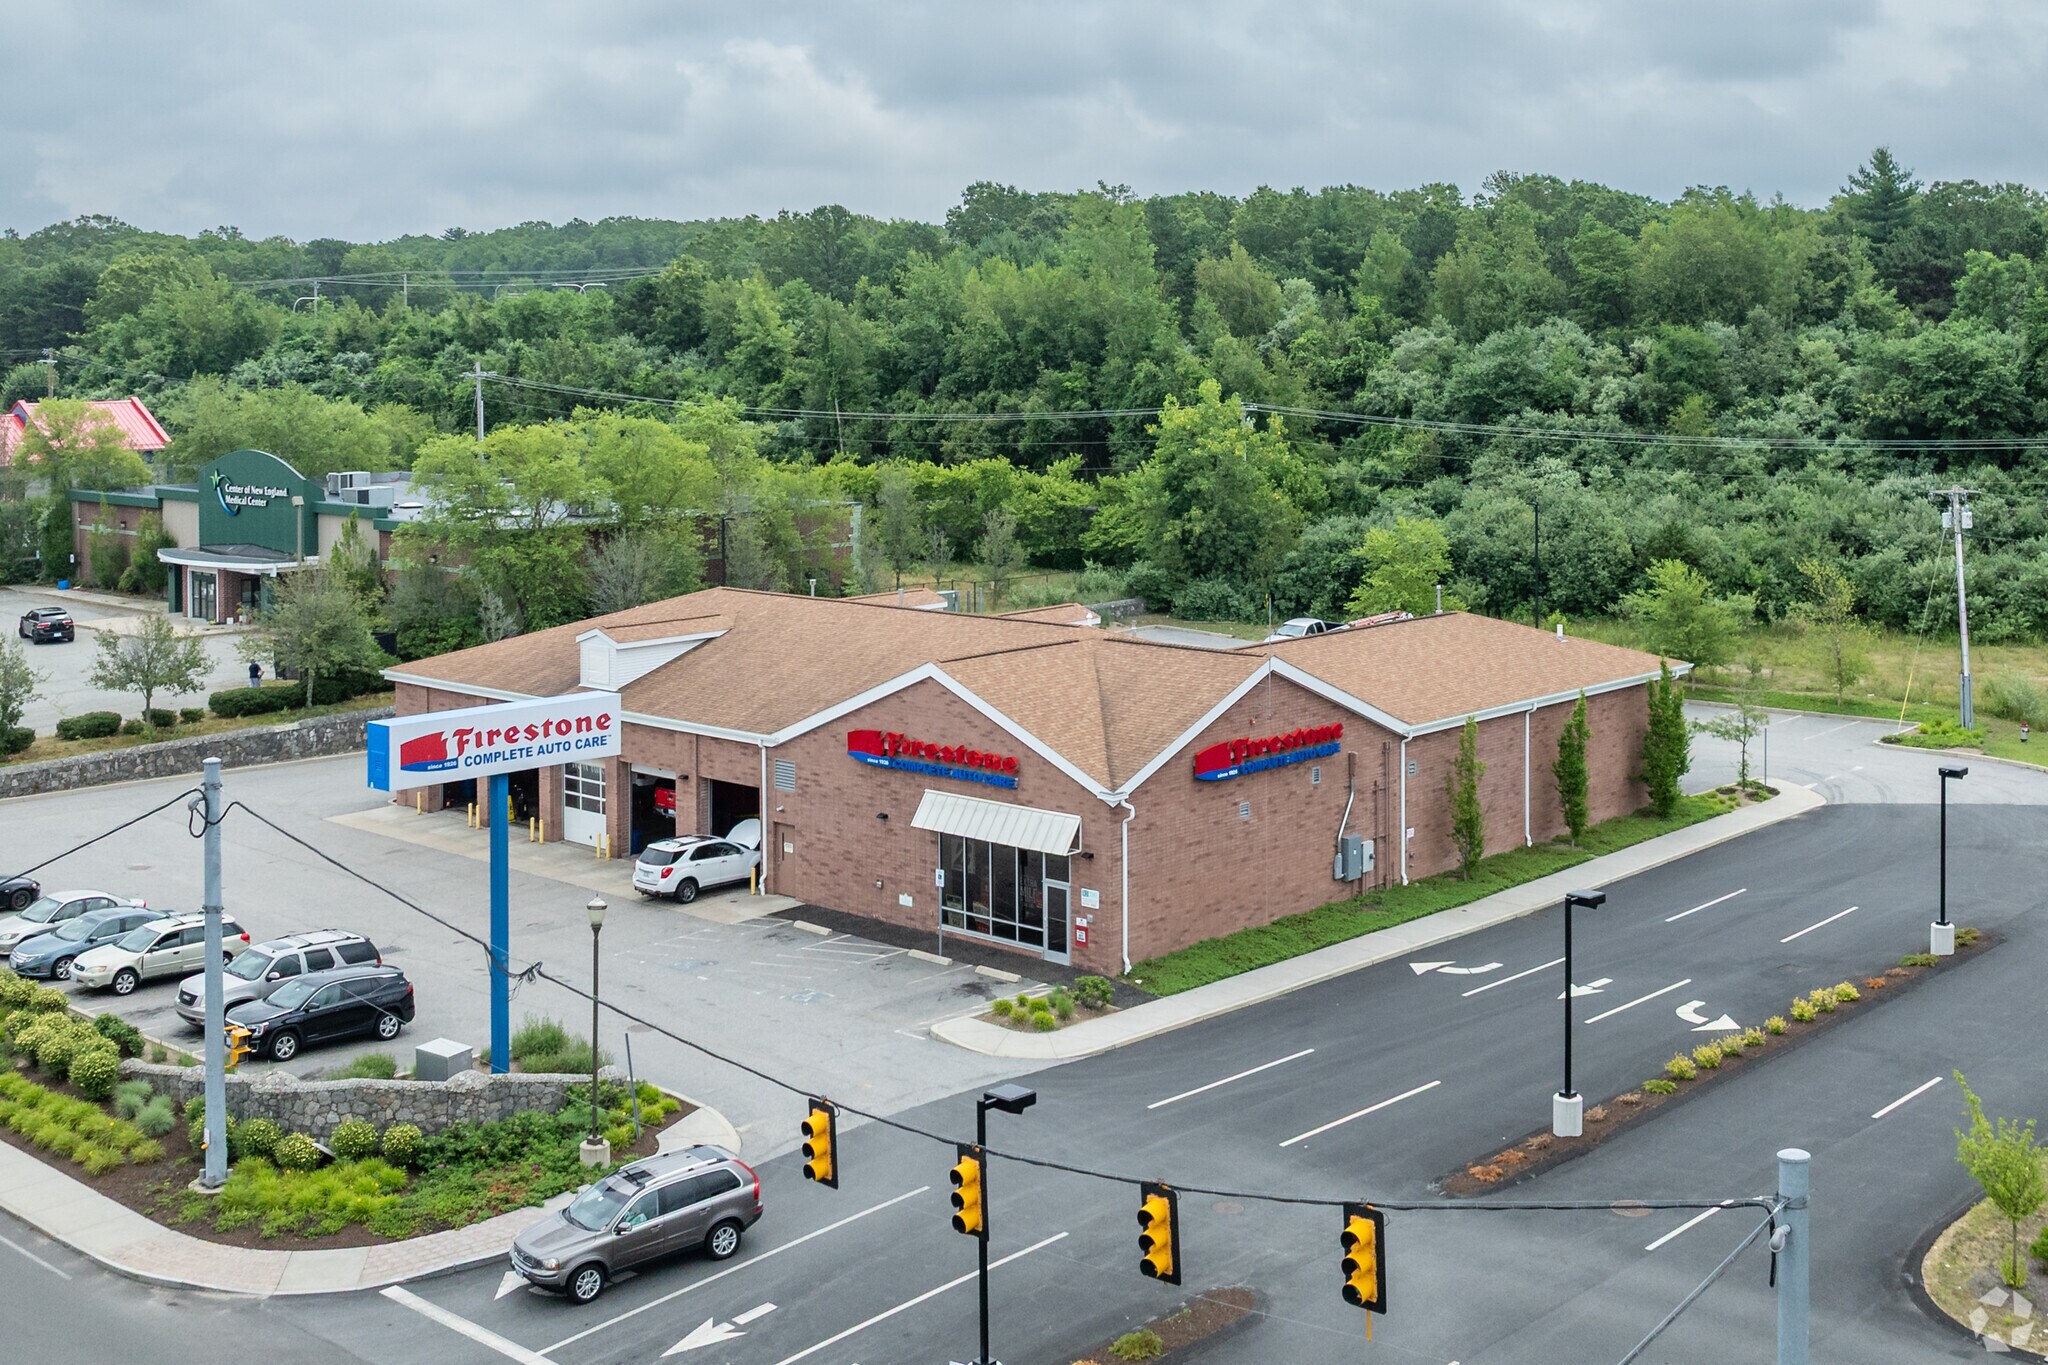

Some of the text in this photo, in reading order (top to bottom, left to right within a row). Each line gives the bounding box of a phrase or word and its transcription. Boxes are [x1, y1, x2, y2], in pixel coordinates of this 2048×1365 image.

[225, 484, 244, 493] Center
[244, 485, 250, 494] of
[251, 486, 263, 494] New
[225, 495, 267, 506] Medical Center
[452, 712, 612, 757] Firestone
[1232, 722, 1344, 765] Firestone
[464, 735, 608, 767] COMPLETE AUTO CARE
[884, 731, 1019, 774] Firestone
[1240, 742, 1341, 774] COMPLETE AUTO CARE
[892, 759, 1015, 789] COMPLETE AUTO CARE
